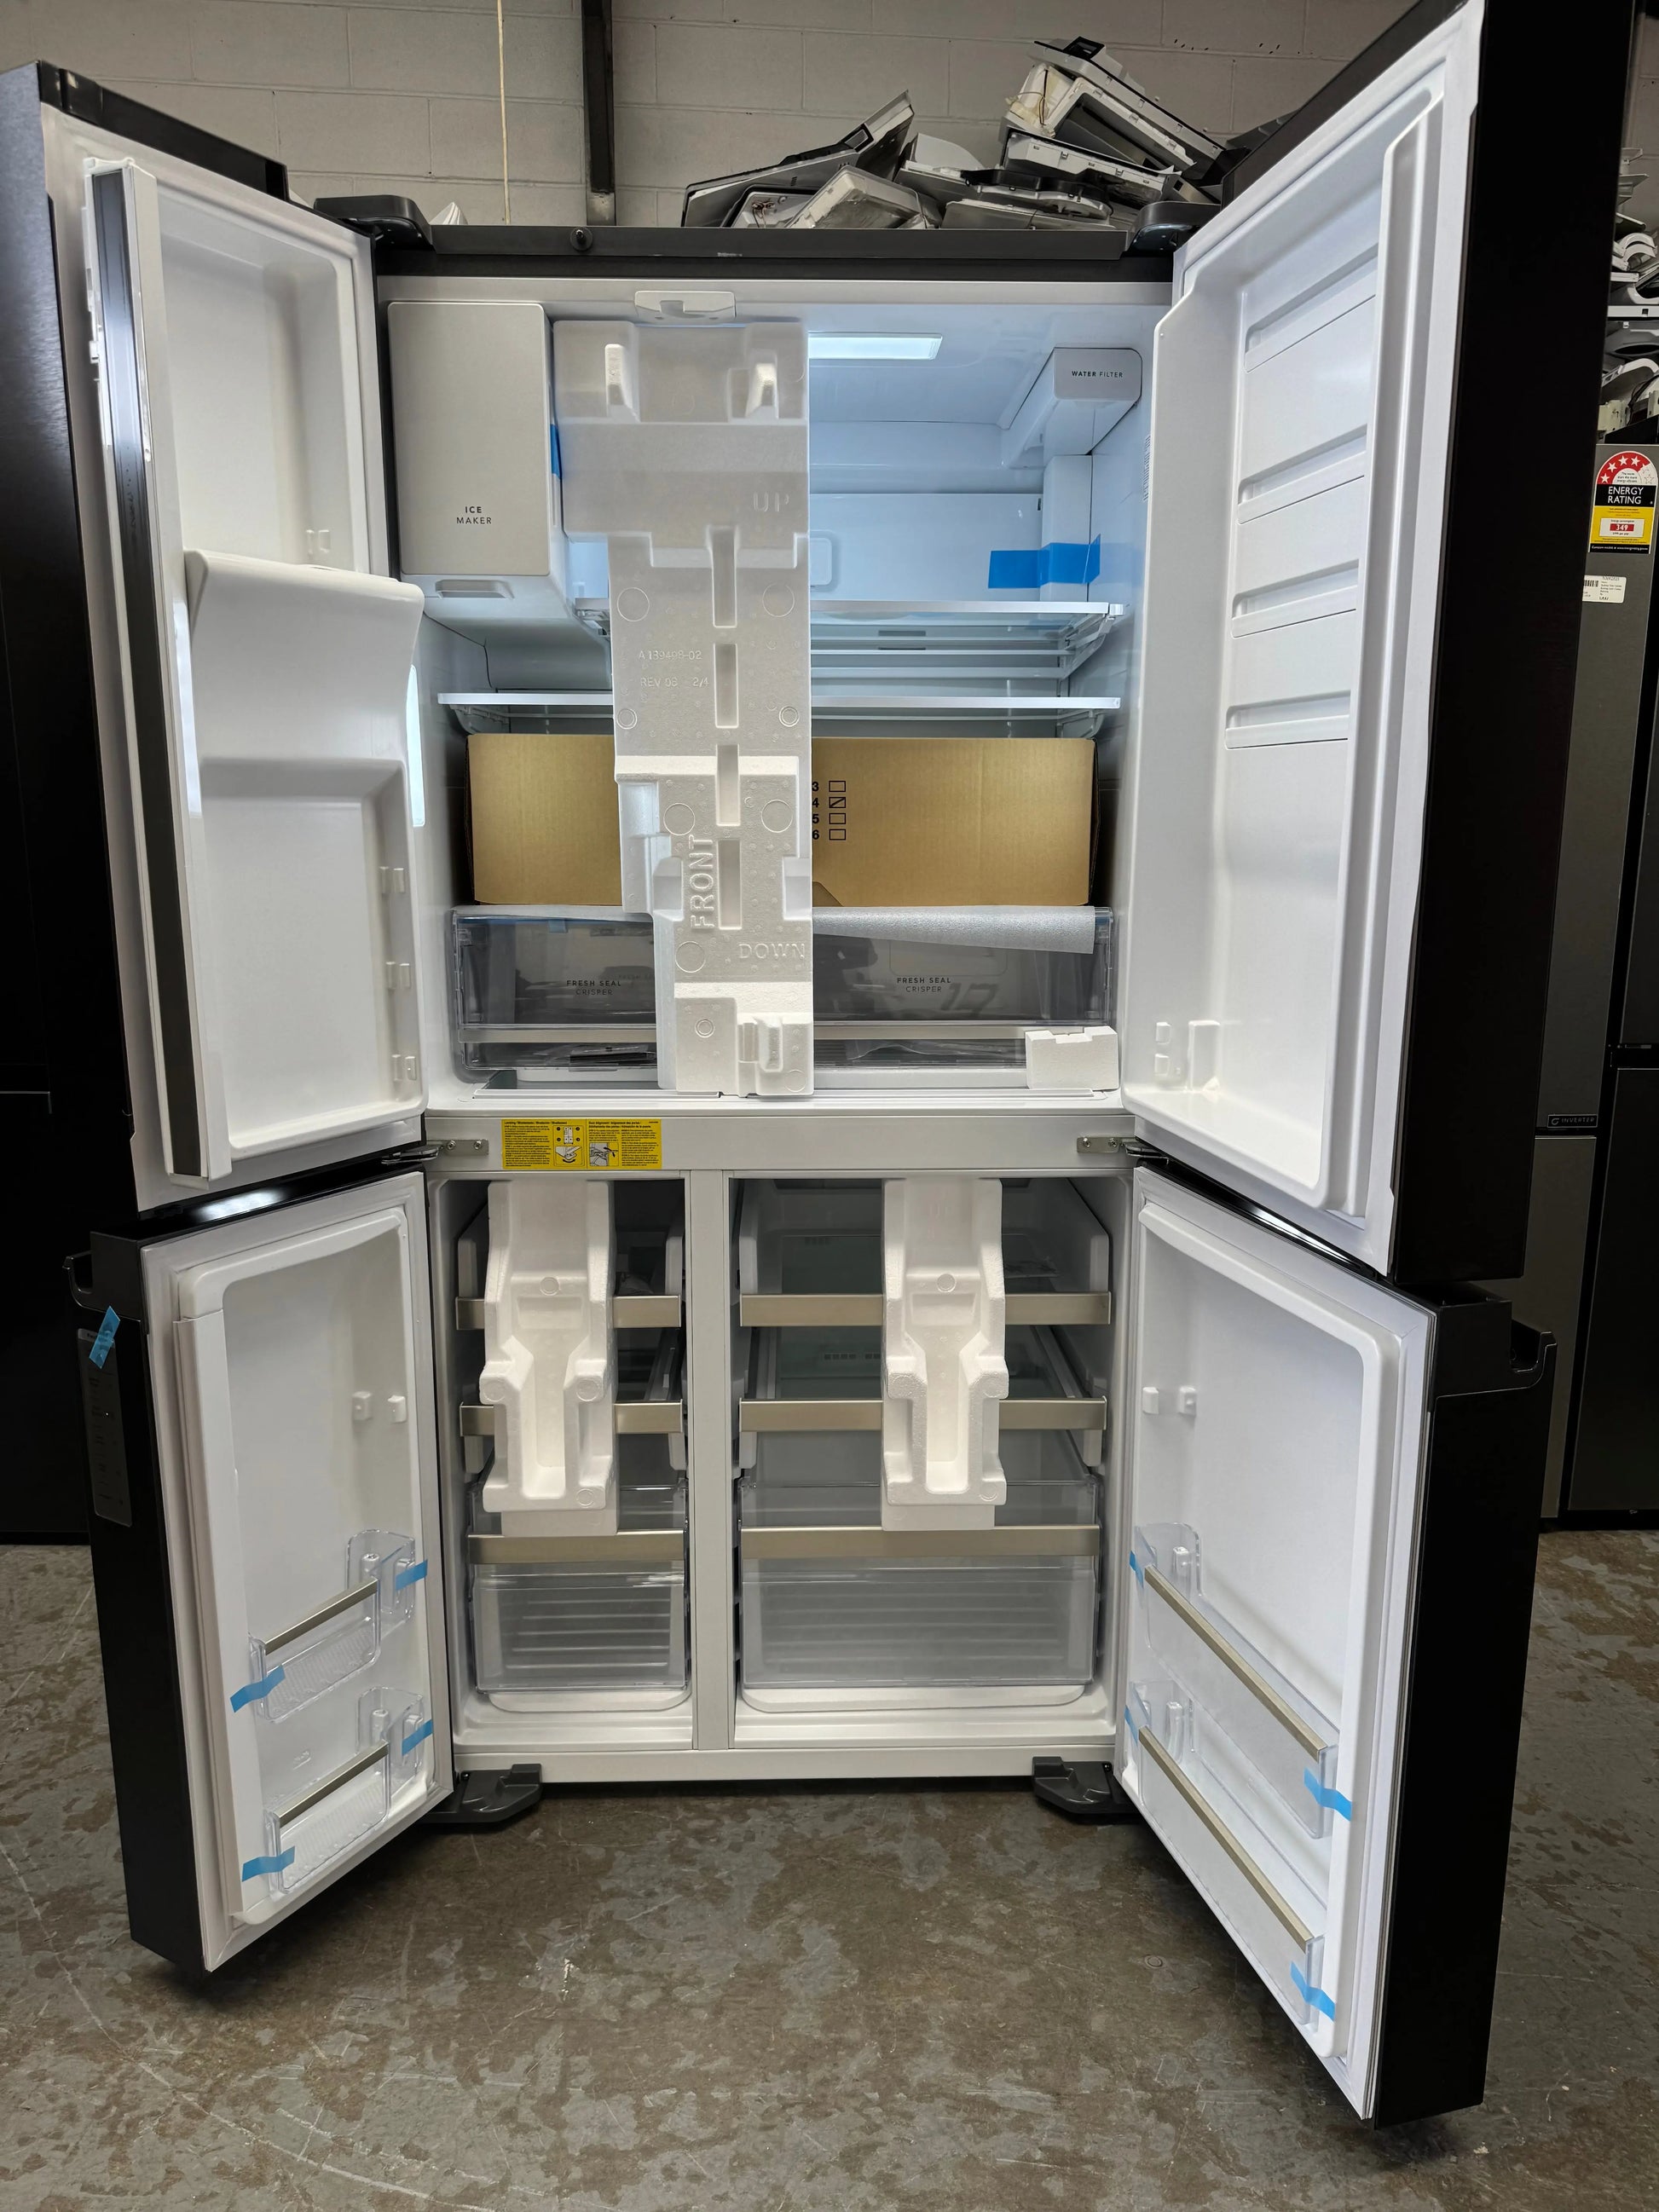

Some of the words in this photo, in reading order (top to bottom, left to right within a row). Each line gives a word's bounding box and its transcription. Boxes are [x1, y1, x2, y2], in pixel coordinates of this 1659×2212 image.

[1608, 486, 1644, 495] ENERGY
[753, 492, 789, 512] UP
[1607, 495, 1642, 505] RATING
[465, 505, 483, 514] ICE
[456, 517, 492, 525] MAKER
[640, 676, 662, 688] REV
[692, 676, 710, 688] 2/4
[812, 781, 819, 792] 3
[812, 797, 819, 808] 4
[812, 813, 820, 824] 5
[812, 829, 820, 840] 6
[689, 834, 714, 927] FRONT
[738, 943, 805, 959] DOWN
